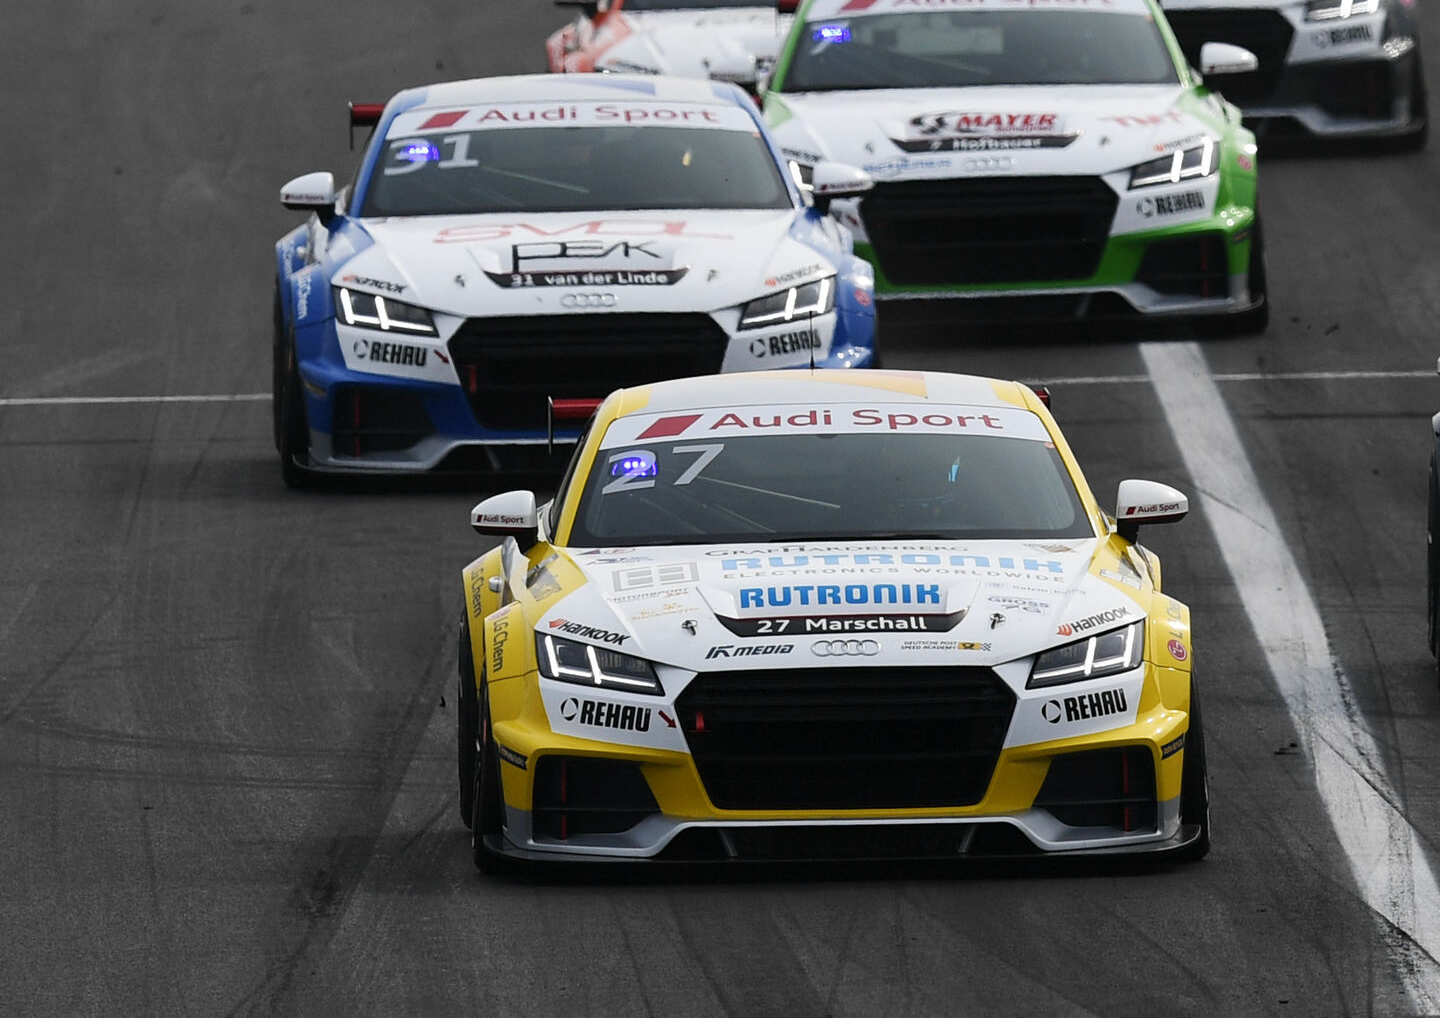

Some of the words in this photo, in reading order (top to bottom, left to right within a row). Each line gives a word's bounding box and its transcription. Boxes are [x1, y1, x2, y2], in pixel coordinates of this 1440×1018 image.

[478, 107, 577, 123] Audi
[594, 106, 721, 125] Sport
[958, 113, 1058, 128] MAYER
[384, 133, 480, 176] 31
[511, 274, 536, 287] 31
[544, 274, 580, 286] van
[582, 272, 616, 285] der
[618, 270, 669, 285] Linde
[769, 329, 822, 355] REHAU
[369, 339, 429, 367] REHAU
[708, 410, 832, 431] Audi
[852, 408, 1005, 431] Sport
[601, 443, 725, 495] 27
[1137, 505, 1157, 513] Audi
[1159, 503, 1180, 512] Sport
[483, 514, 499, 523] Audi
[500, 515, 525, 524] Sport
[720, 554, 1064, 574] RUTRONIK
[723, 567, 899, 579] ELECTRONICS
[914, 567, 1066, 583] WORLDWIDE
[739, 583, 942, 609] RUTRONIK
[492, 615, 510, 632] LG
[756, 618, 791, 633] 27
[805, 616, 927, 632] Marschall
[492, 631, 508, 672] Chem
[1063, 688, 1128, 722] REHAU
[580, 700, 652, 732] REHAU
